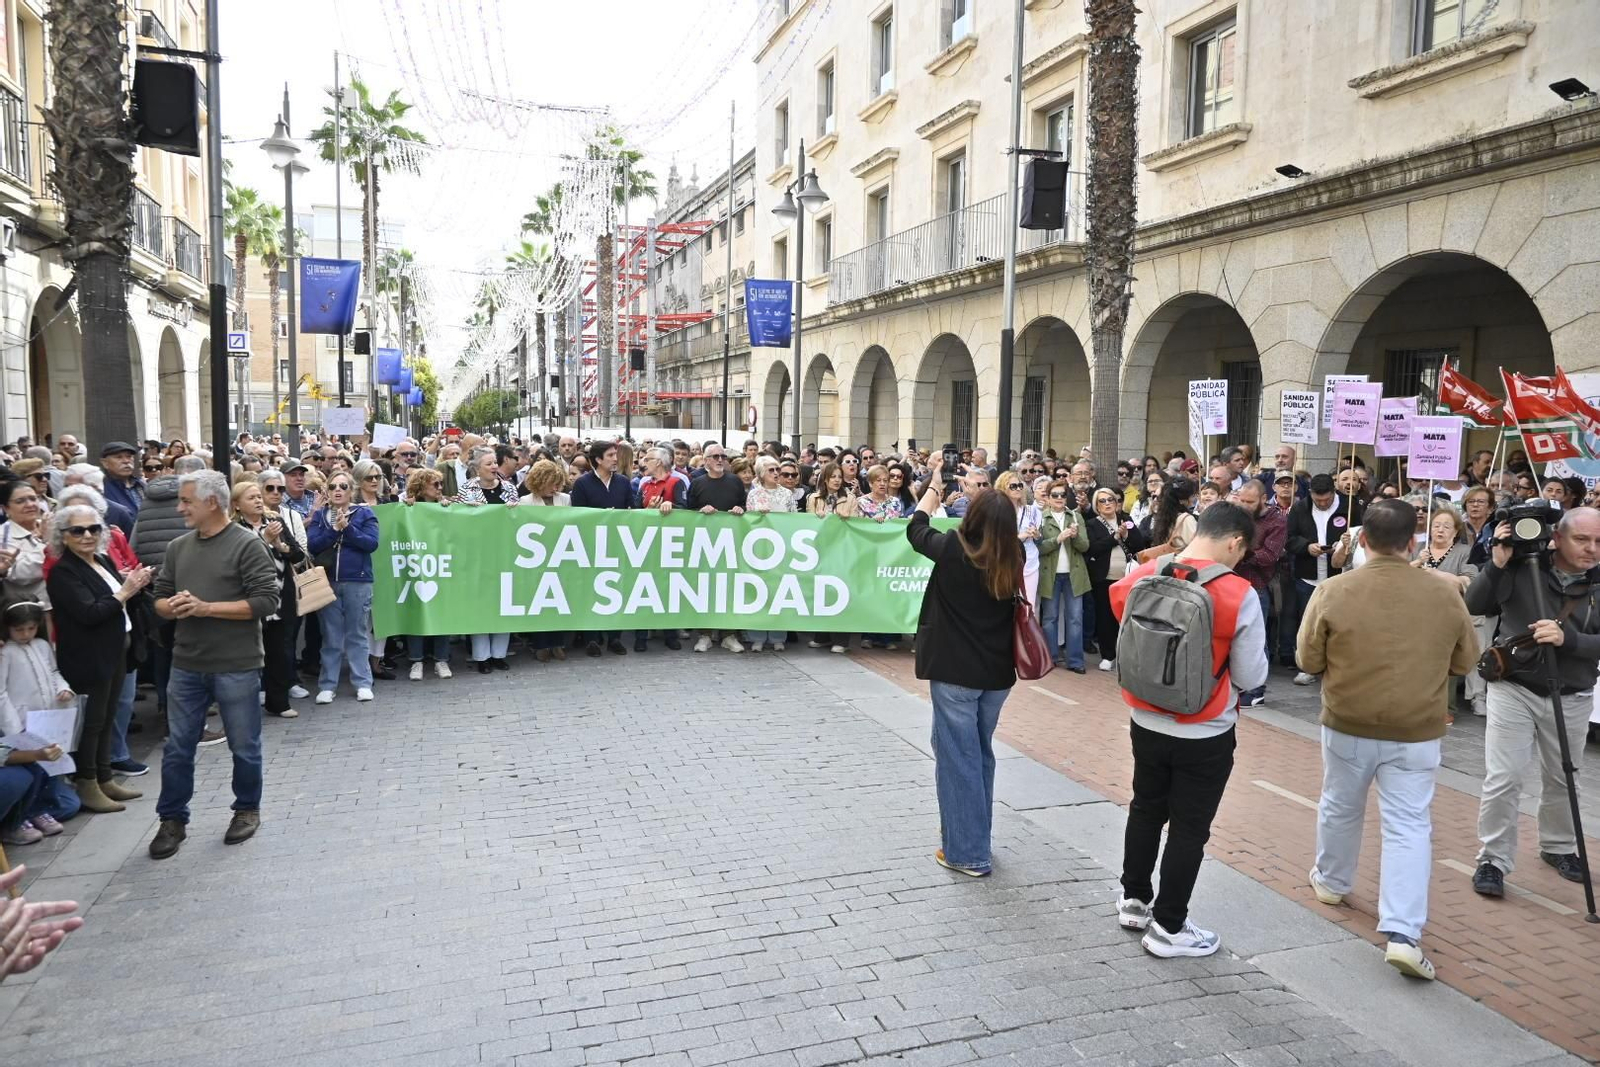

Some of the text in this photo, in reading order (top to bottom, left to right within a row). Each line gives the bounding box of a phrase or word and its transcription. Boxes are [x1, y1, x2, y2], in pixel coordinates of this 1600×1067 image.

[1191, 382, 1225, 390] SANIDAD
[1191, 390, 1225, 398] PÚBLICA
[1283, 401, 1315, 409] PÚBLICA
[1423, 433, 1446, 441] MATA
[390, 540, 428, 551] Huelva
[514, 522, 820, 571] SALVEMOS
[391, 554, 452, 578] PSOE
[876, 566, 933, 578] HUELVA
[500, 571, 850, 616] LA SANIDAD
